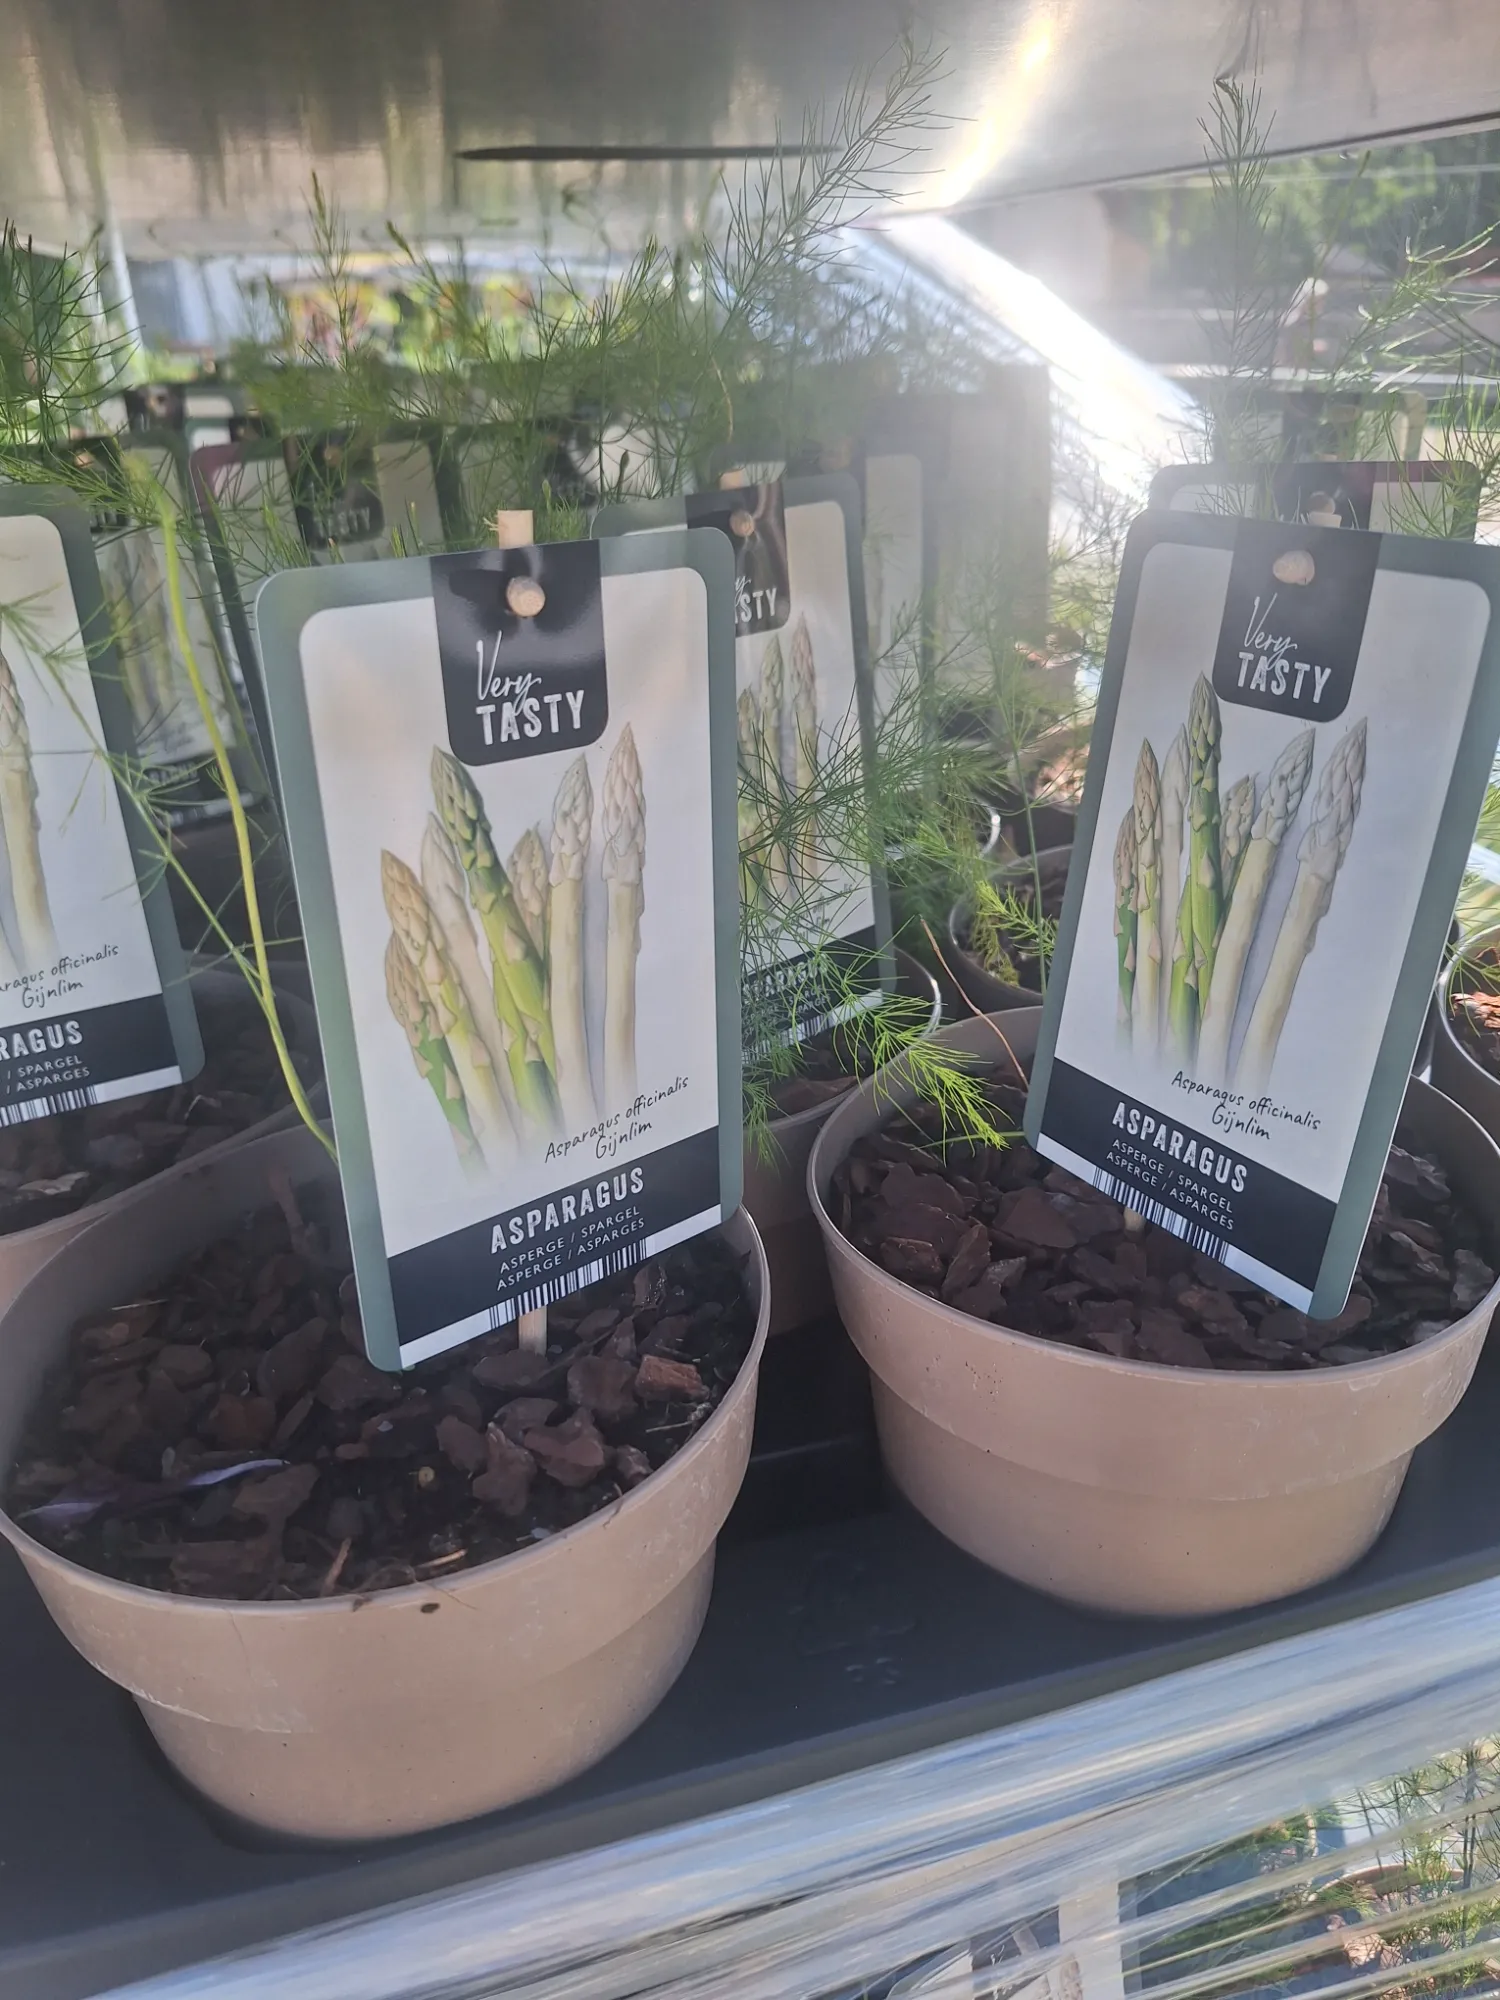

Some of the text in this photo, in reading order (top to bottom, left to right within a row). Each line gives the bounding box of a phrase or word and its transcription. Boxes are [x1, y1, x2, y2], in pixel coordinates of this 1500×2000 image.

[735, 587, 777, 624] STY
[1244, 592, 1298, 671] Very
[476, 630, 542, 716] Very
[1237, 651, 1332, 704] TASTY
[475, 689, 585, 745] TASTY
[0, 944, 119, 992] ragus officinalis
[22, 980, 84, 1008] Gijnlim
[16, 1067, 90, 1092] ASPARGES
[18, 1055, 83, 1078] SPARGEL
[544, 1076, 689, 1163] Asparagus officinalis
[1171, 1071, 1321, 1131] Asparagus officinalis
[1211, 1103, 1270, 1140] Gijnlim
[595, 1121, 652, 1159] Gijnlim
[1112, 1101, 1248, 1192] ASPARAGUS
[1106, 1151, 1158, 1187] ASPERGE
[1169, 1187, 1234, 1230] ASPARGES
[1112, 1139, 1165, 1175] ASPERGE
[1177, 1174, 1233, 1213] SPARGEL
[491, 1167, 645, 1254] ASPARAGUS
[500, 1236, 565, 1274] ASPERGE
[581, 1205, 640, 1238] SPARGEL
[497, 1257, 562, 1291] ASPERGE
[577, 1218, 645, 1255] ASPARGES
